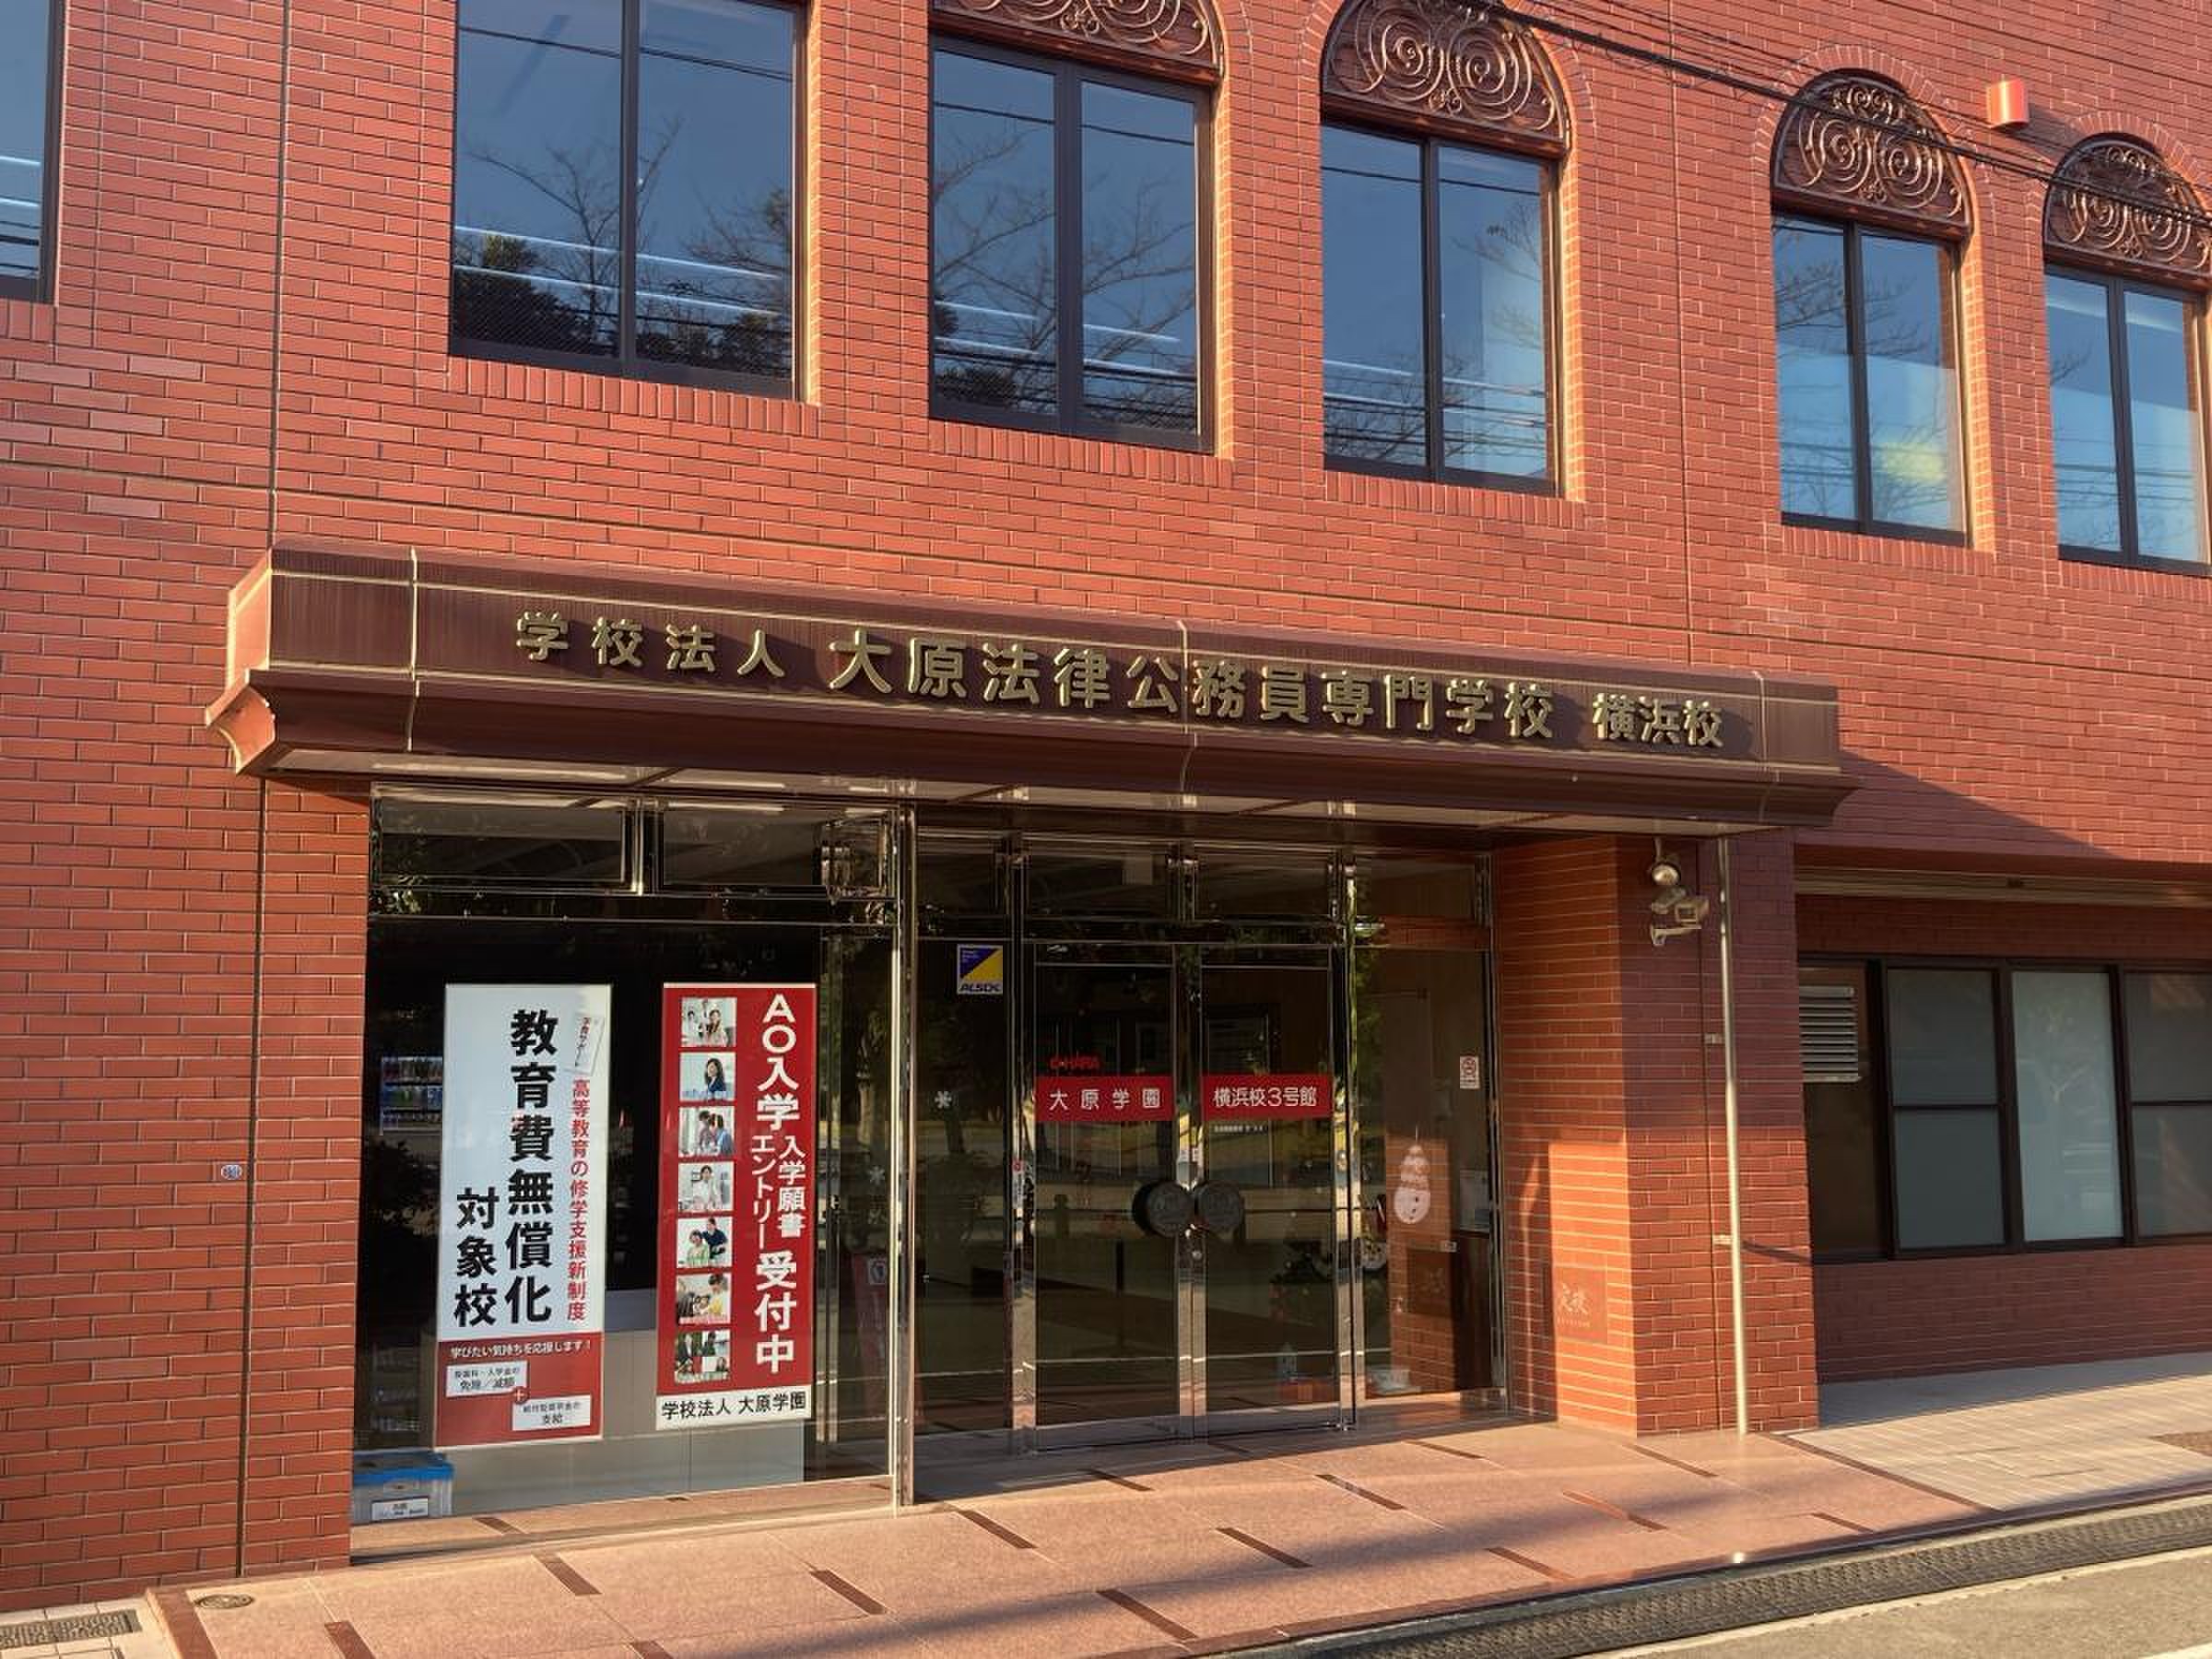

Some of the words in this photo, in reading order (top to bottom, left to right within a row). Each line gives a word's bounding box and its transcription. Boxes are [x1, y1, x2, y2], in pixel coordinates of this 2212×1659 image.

[516, 610, 785, 677] 学校法人
[829, 627, 1554, 738] 大原法律公務員専門学校
[1592, 692, 1724, 747] 横浜校
[757, 994, 800, 1132] AO入学
[1049, 1088, 1161, 1111] 大原学園
[1213, 1086, 1318, 1108] 横浜校3号館
[504, 1008, 559, 1324] 教育費無償化
[567, 1079, 591, 1321] 高等教育の修学支援新制度
[751, 1135, 776, 1250] エントリー
[777, 1135, 806, 1238] 入学願書
[453, 1186, 500, 1328] 対象校
[754, 1250, 797, 1374] 受付中
[661, 1397, 731, 1421] 学校法人
[737, 1390, 807, 1414] 大原学園
